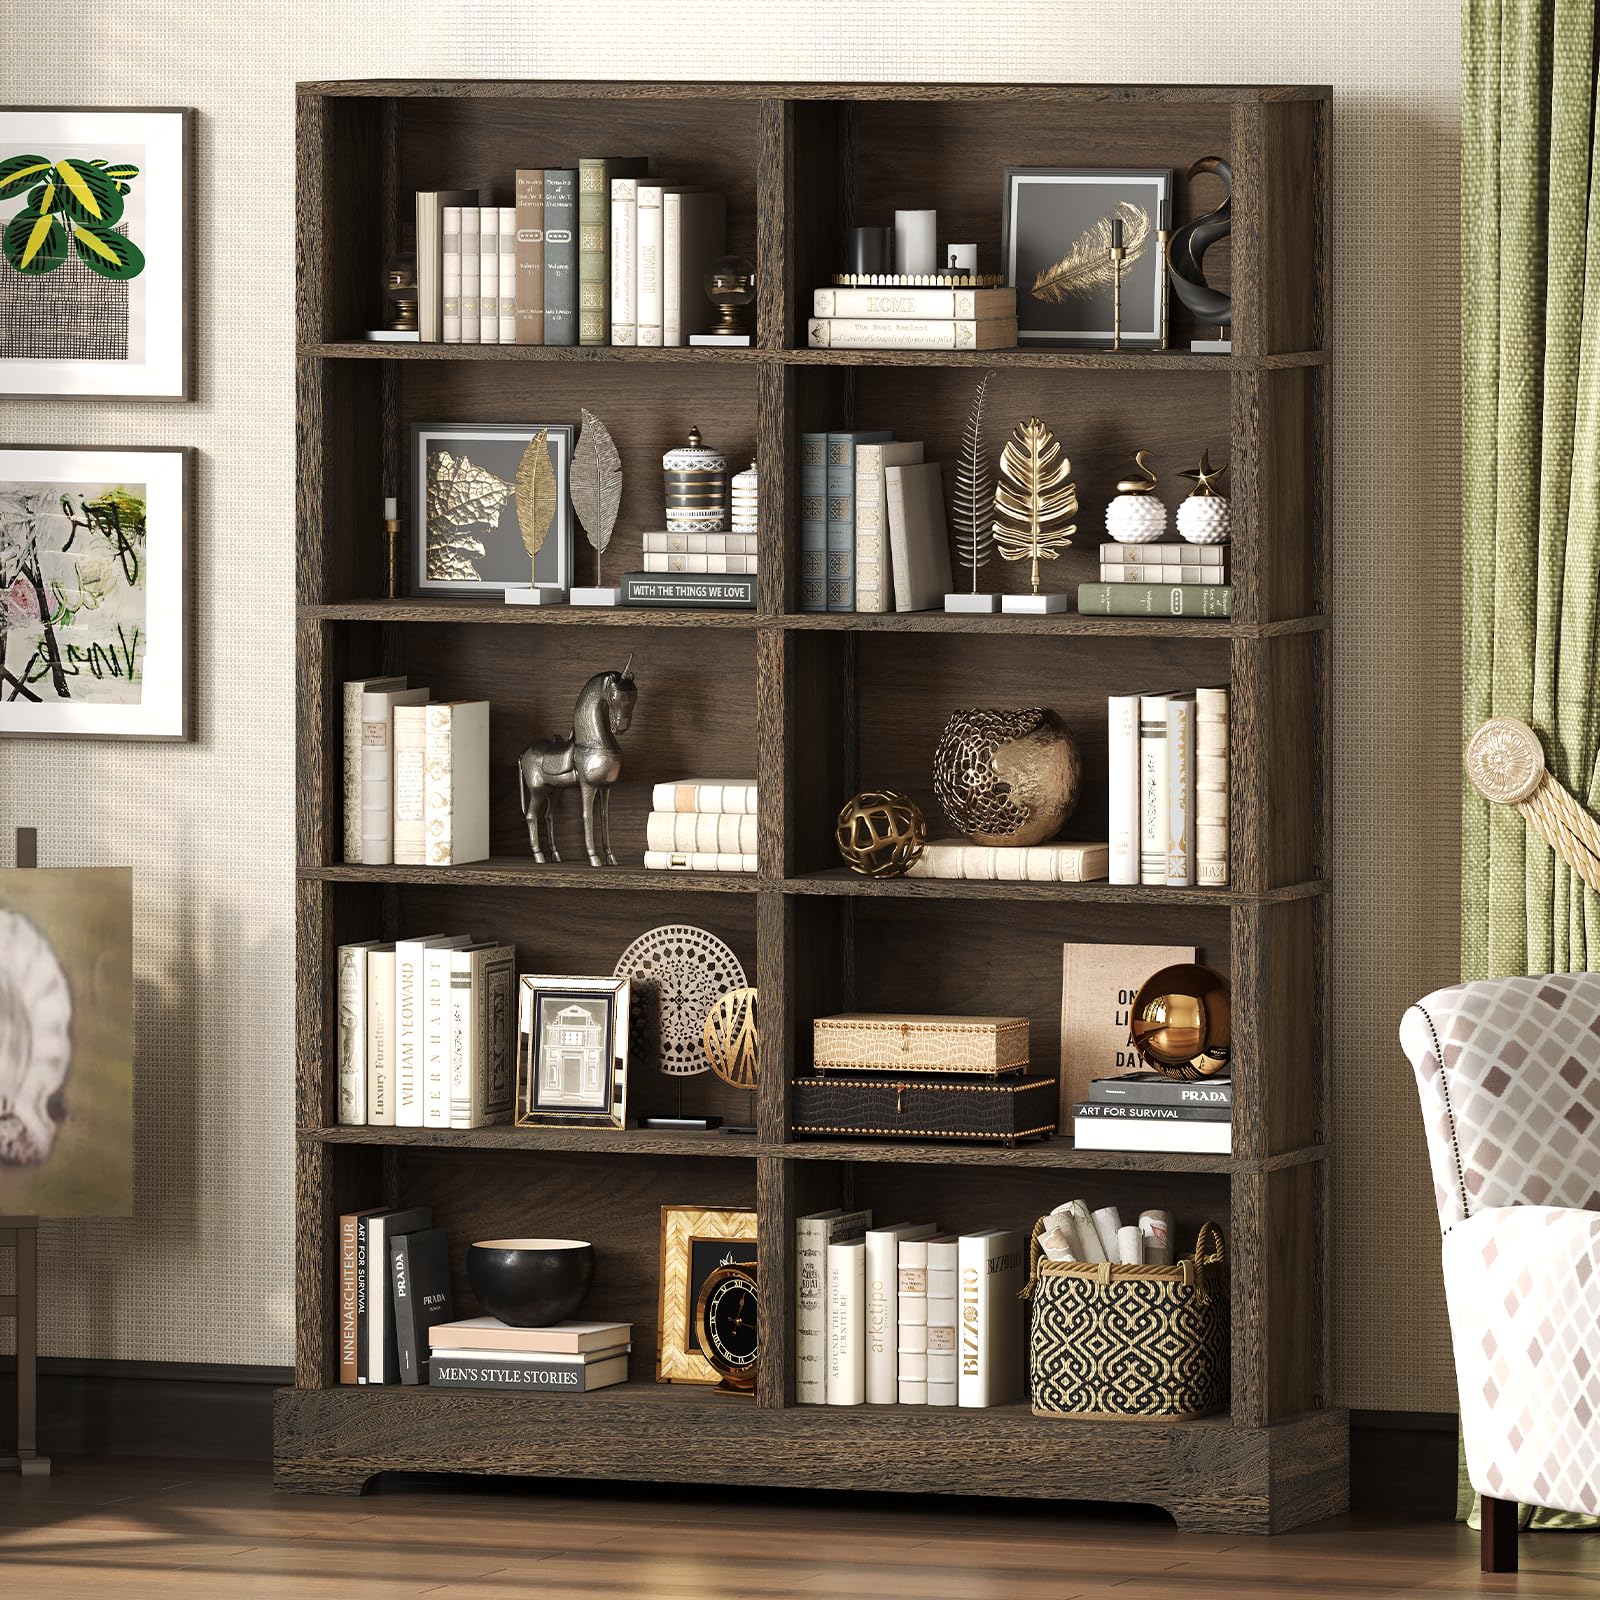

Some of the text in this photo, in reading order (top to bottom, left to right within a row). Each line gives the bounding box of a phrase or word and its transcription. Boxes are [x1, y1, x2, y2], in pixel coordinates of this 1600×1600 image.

[642, 245, 656, 294] HOME
[866, 297, 916, 313] HOME
[633, 585, 745, 598] WITH THE THINGS WE LOVE
[1118, 990, 1139, 1005] ON
[376, 1009, 385, 1069] Furniture
[402, 962, 414, 1106] WILLIAM YEOWARD
[1116, 1052, 1144, 1068] DAY
[376, 1073, 387, 1116] Luxury
[1181, 1090, 1228, 1102] PRADA
[1079, 1106, 1179, 1119] ART FOR SURVIVAL
[395, 1252, 407, 1298] PRADA
[343, 1223, 355, 1365] INNENARCHITEKTUR
[423, 1293, 446, 1306] PRADA
[832, 1267, 840, 1379] AROUND THE HOUSE
[868, 1279, 889, 1353] arketipo
[481, 1369, 521, 1383] STYLE
[523, 1370, 578, 1385] STORIES
